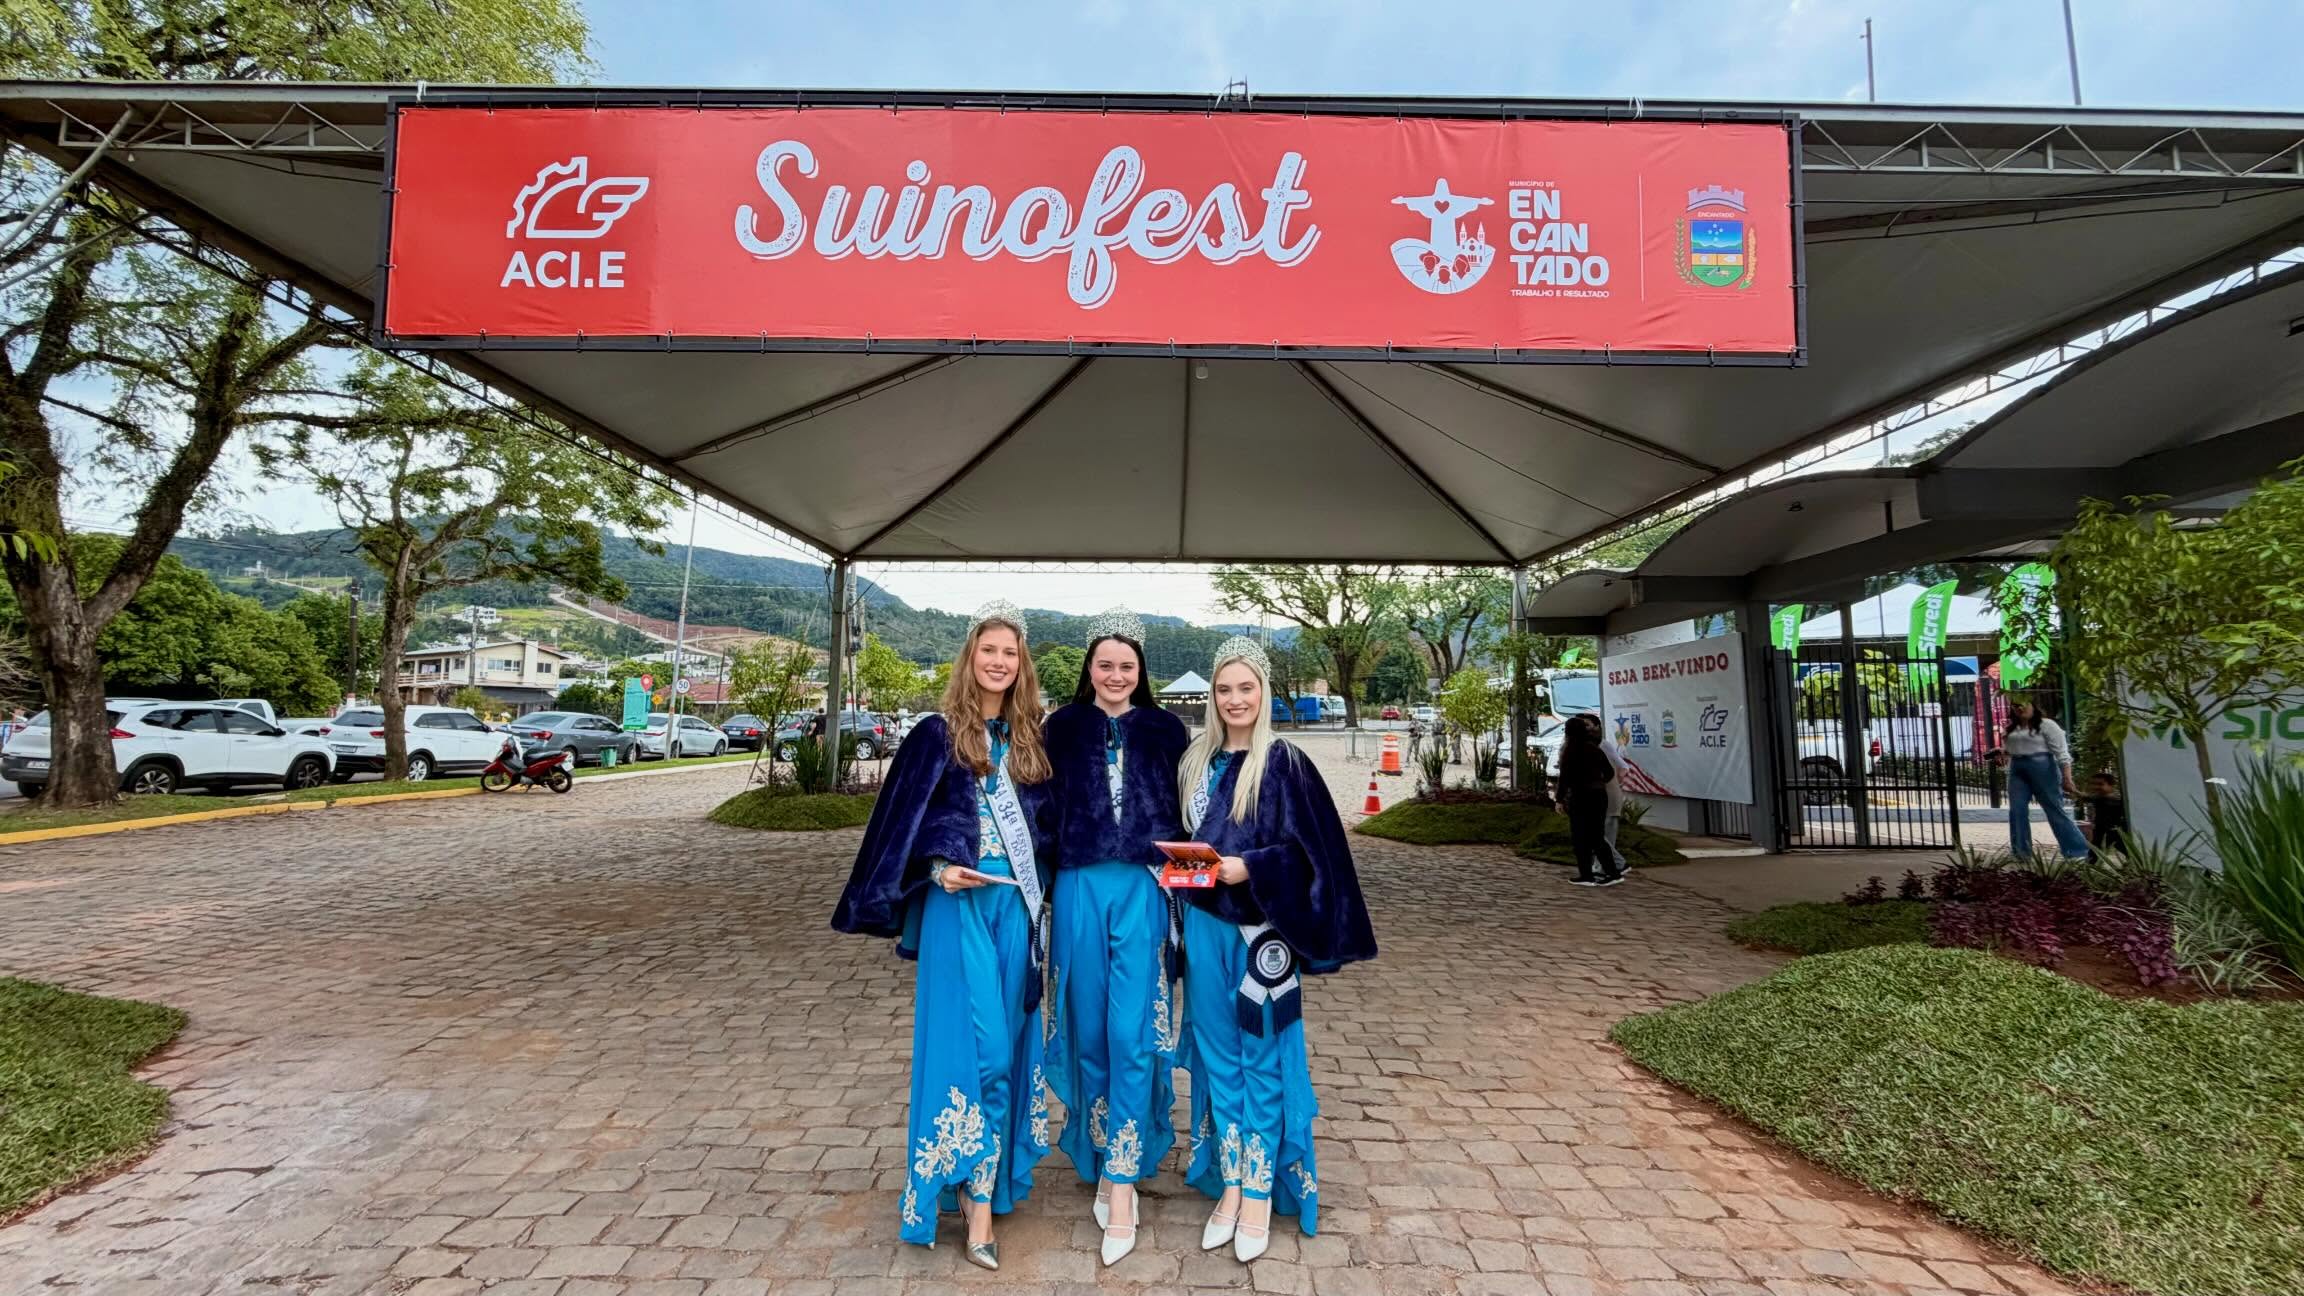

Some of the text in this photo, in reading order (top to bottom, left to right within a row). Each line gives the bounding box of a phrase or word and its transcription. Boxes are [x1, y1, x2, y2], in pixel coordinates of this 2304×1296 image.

[1509, 189, 1561, 219] EN
[734, 139, 1322, 310] Suinofest
[1509, 221, 1589, 253] CAN
[500, 250, 626, 289] ACI.E
[1509, 255, 1610, 286] TADO
[1510, 289, 1553, 297] TRABALHO
[1563, 290, 1610, 298] RESULTADO
[1608, 652, 1730, 686] SEJA BEM-VINDO
[678, 681, 688, 689] 50
[1631, 713, 1641, 724] EN
[1631, 724, 1646, 734] CAN
[1632, 735, 1650, 745] TADO
[1699, 735, 1727, 748] ACI.E
[1010, 841, 1022, 857] DO
[1015, 826, 1028, 856] FESTA
